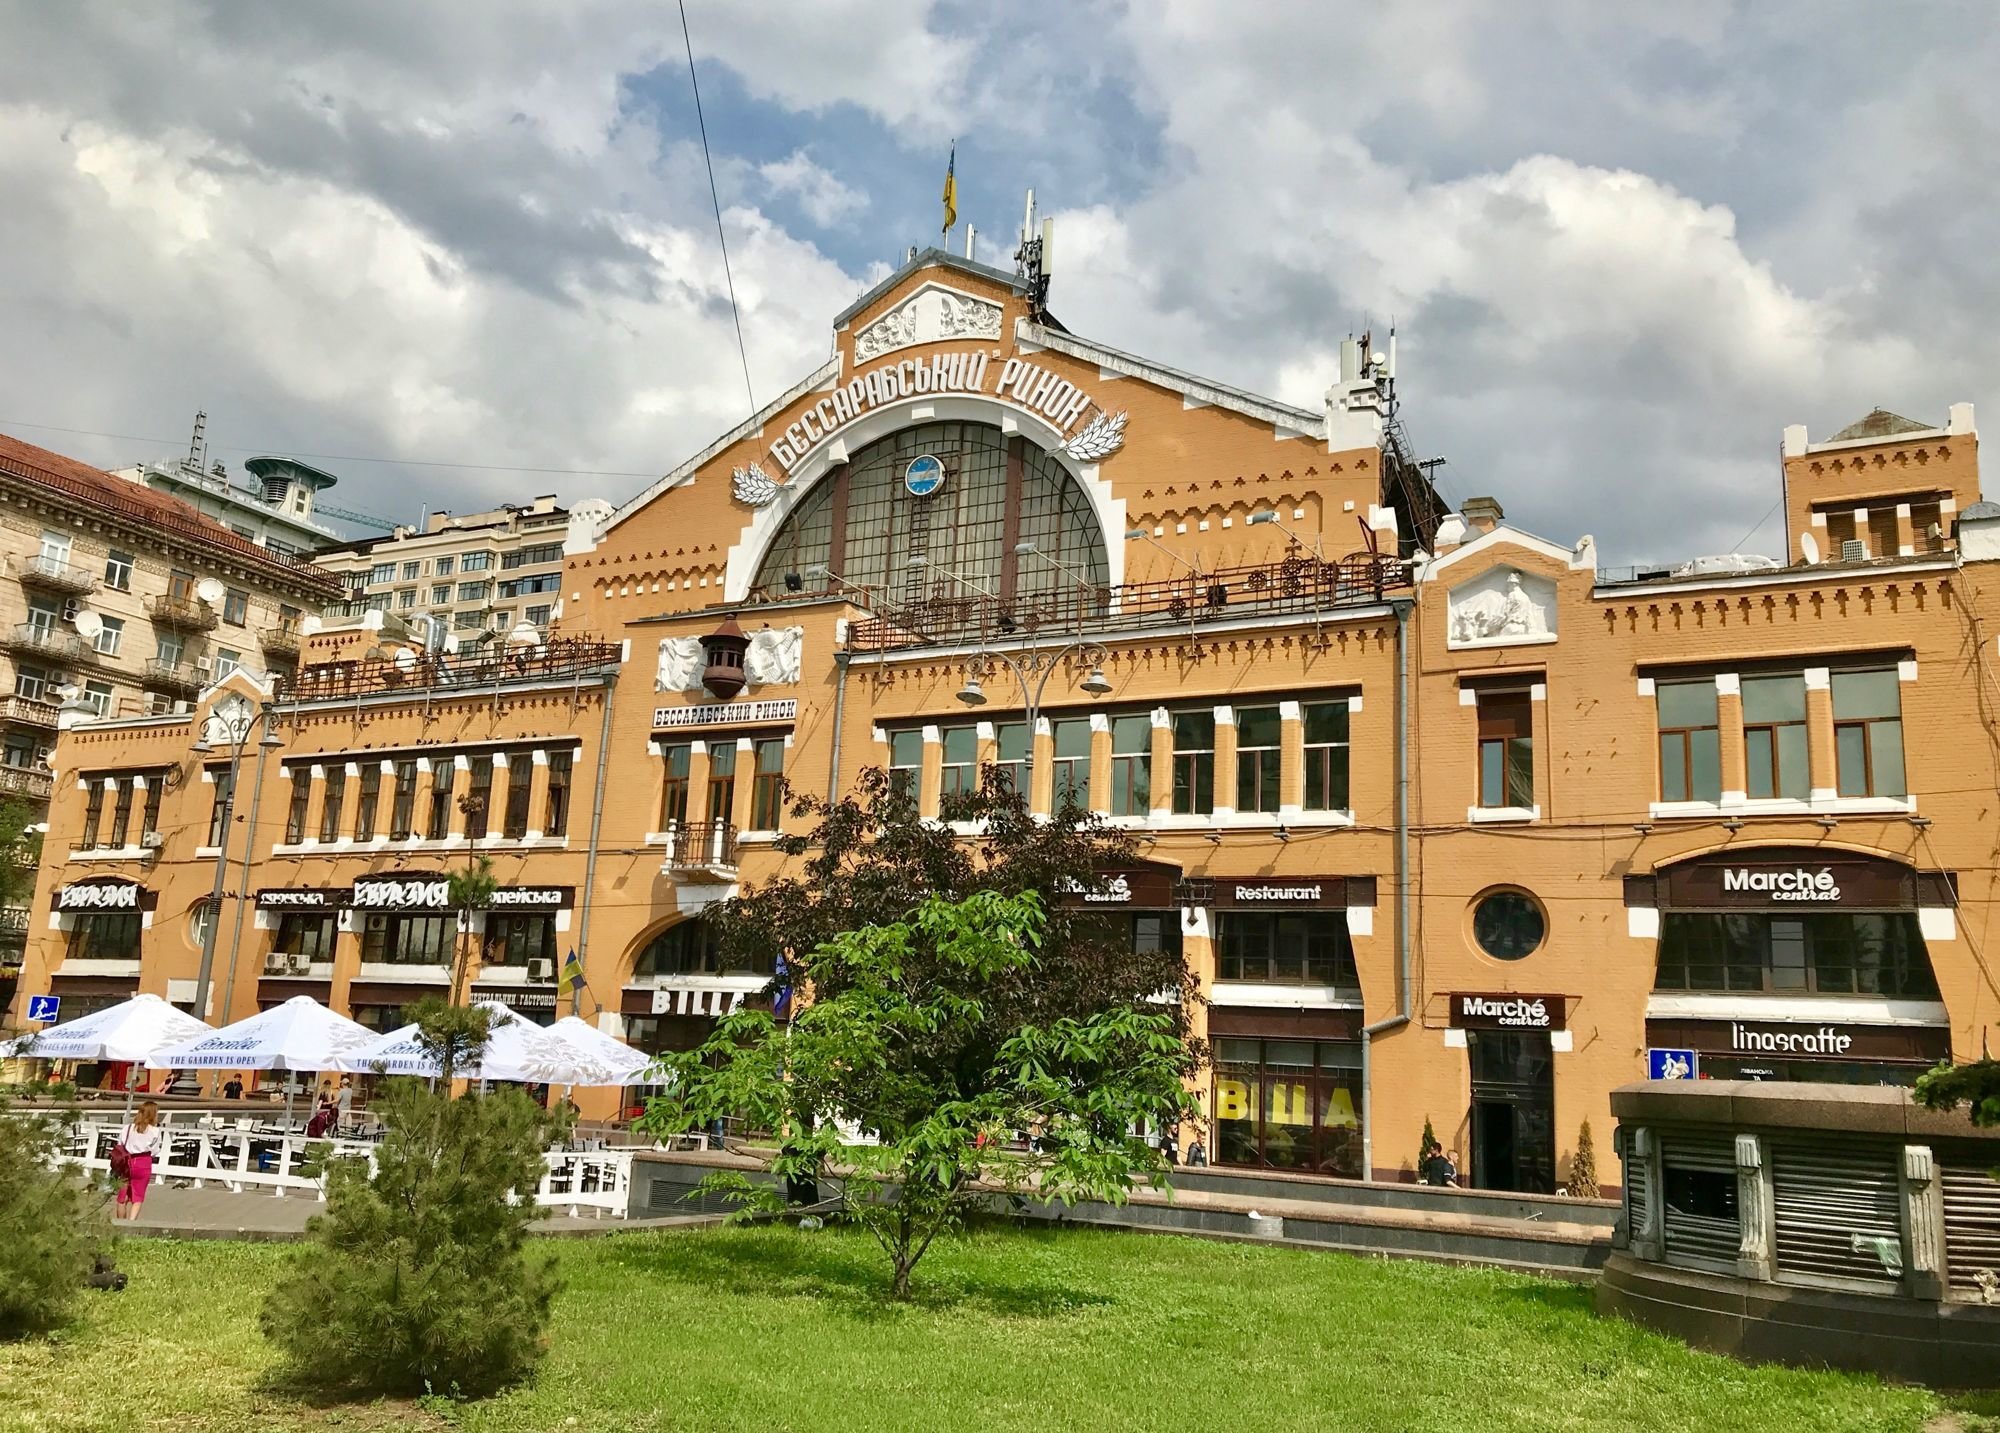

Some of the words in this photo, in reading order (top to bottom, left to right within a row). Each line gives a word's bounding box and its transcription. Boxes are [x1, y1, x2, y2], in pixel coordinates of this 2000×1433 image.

[770, 350, 988, 470] БЕССАРАБСЬКИЙ
[996, 358, 1091, 431] РИНОК
[655, 704, 751, 725] БЕССАРАБСЬКИЙ
[755, 701, 795, 719] РИНОК
[1724, 867, 1834, 890] Marché
[353, 880, 449, 907] ЕВРАЗИЯ
[1235, 884, 1321, 901] Restaurant
[1772, 886, 1841, 901] central
[1463, 997, 1546, 1018] Marché
[1499, 1016, 1550, 1027] central
[170, 1055, 186, 1065] THE
[188, 1055, 223, 1065] GAARDEN
[225, 1055, 234, 1065] IS
[236, 1056, 257, 1065] OPEN
[417, 1062, 425, 1070] IS
[1217, 1080, 1358, 1130] BILLA
